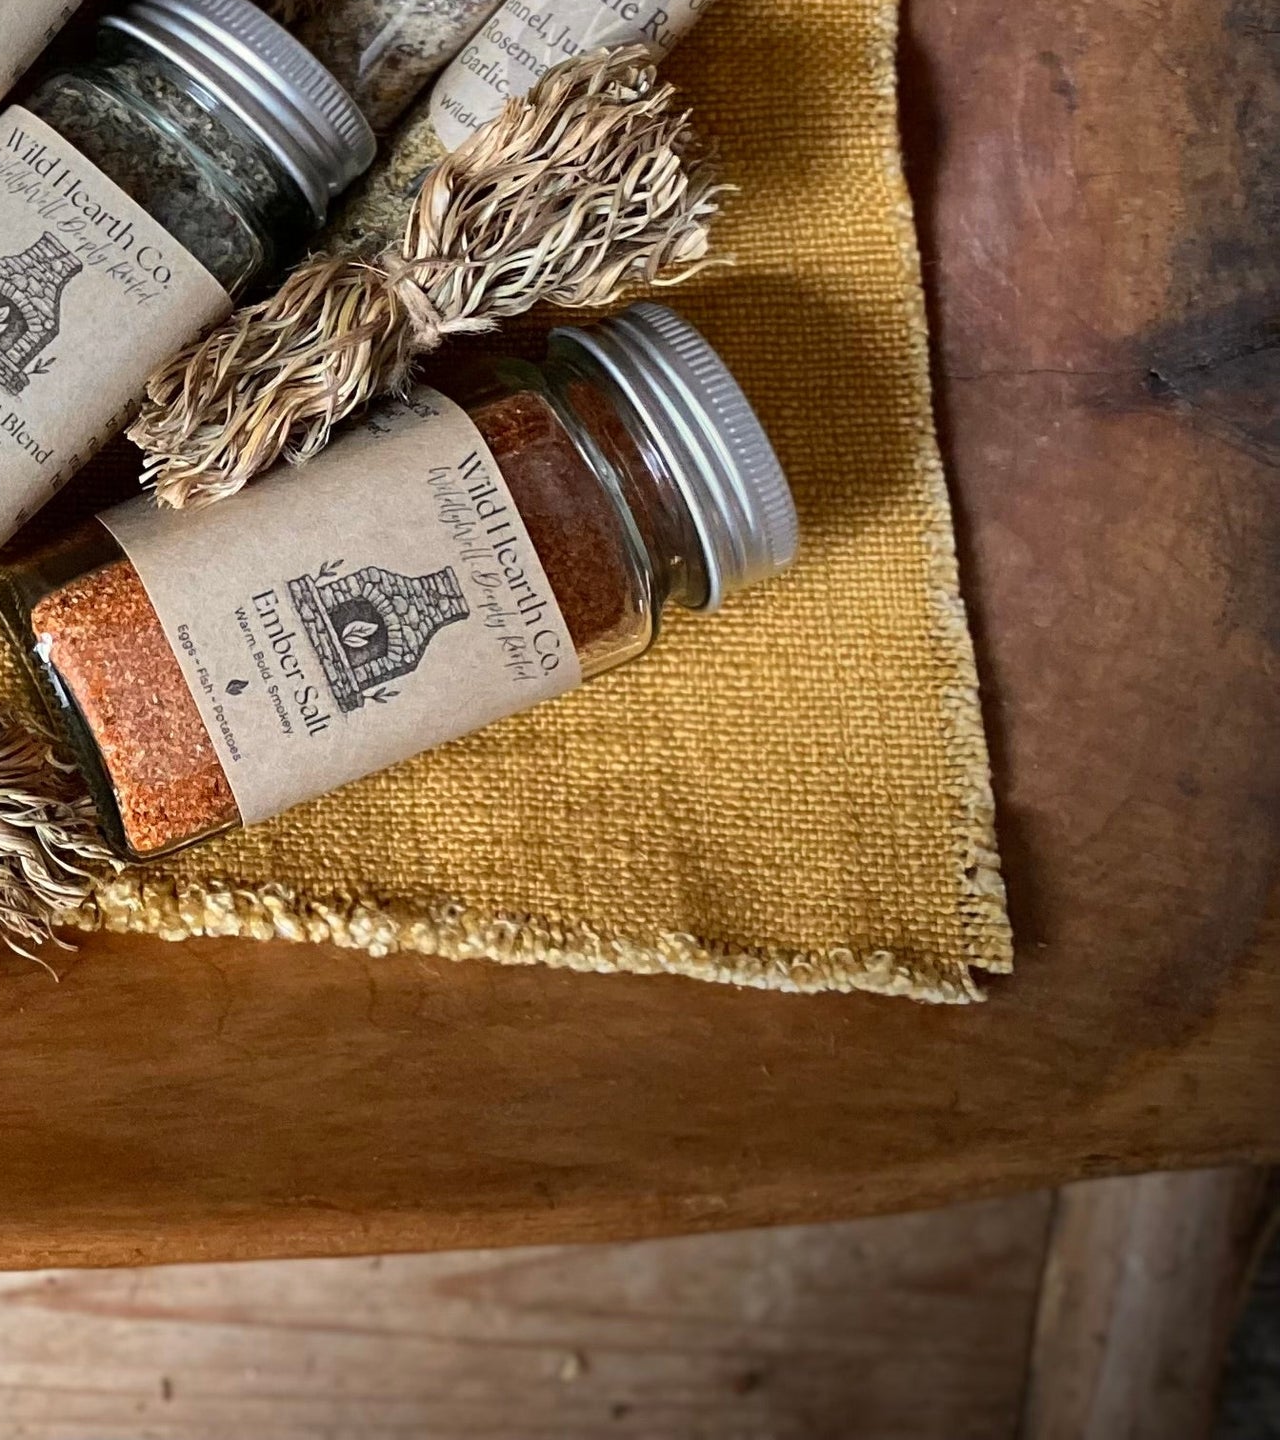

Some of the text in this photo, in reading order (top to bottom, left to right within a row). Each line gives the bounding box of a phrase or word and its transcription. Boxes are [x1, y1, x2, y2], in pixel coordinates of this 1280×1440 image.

[6, 127, 171, 291] Wild Hearth Co.
[0, 405, 54, 465] Blend
[456, 451, 560, 678] Wild Hearth Co.
[176, 624, 241, 761] Eggs Fish Potatoes
[251, 589, 332, 737] Ember Salt
